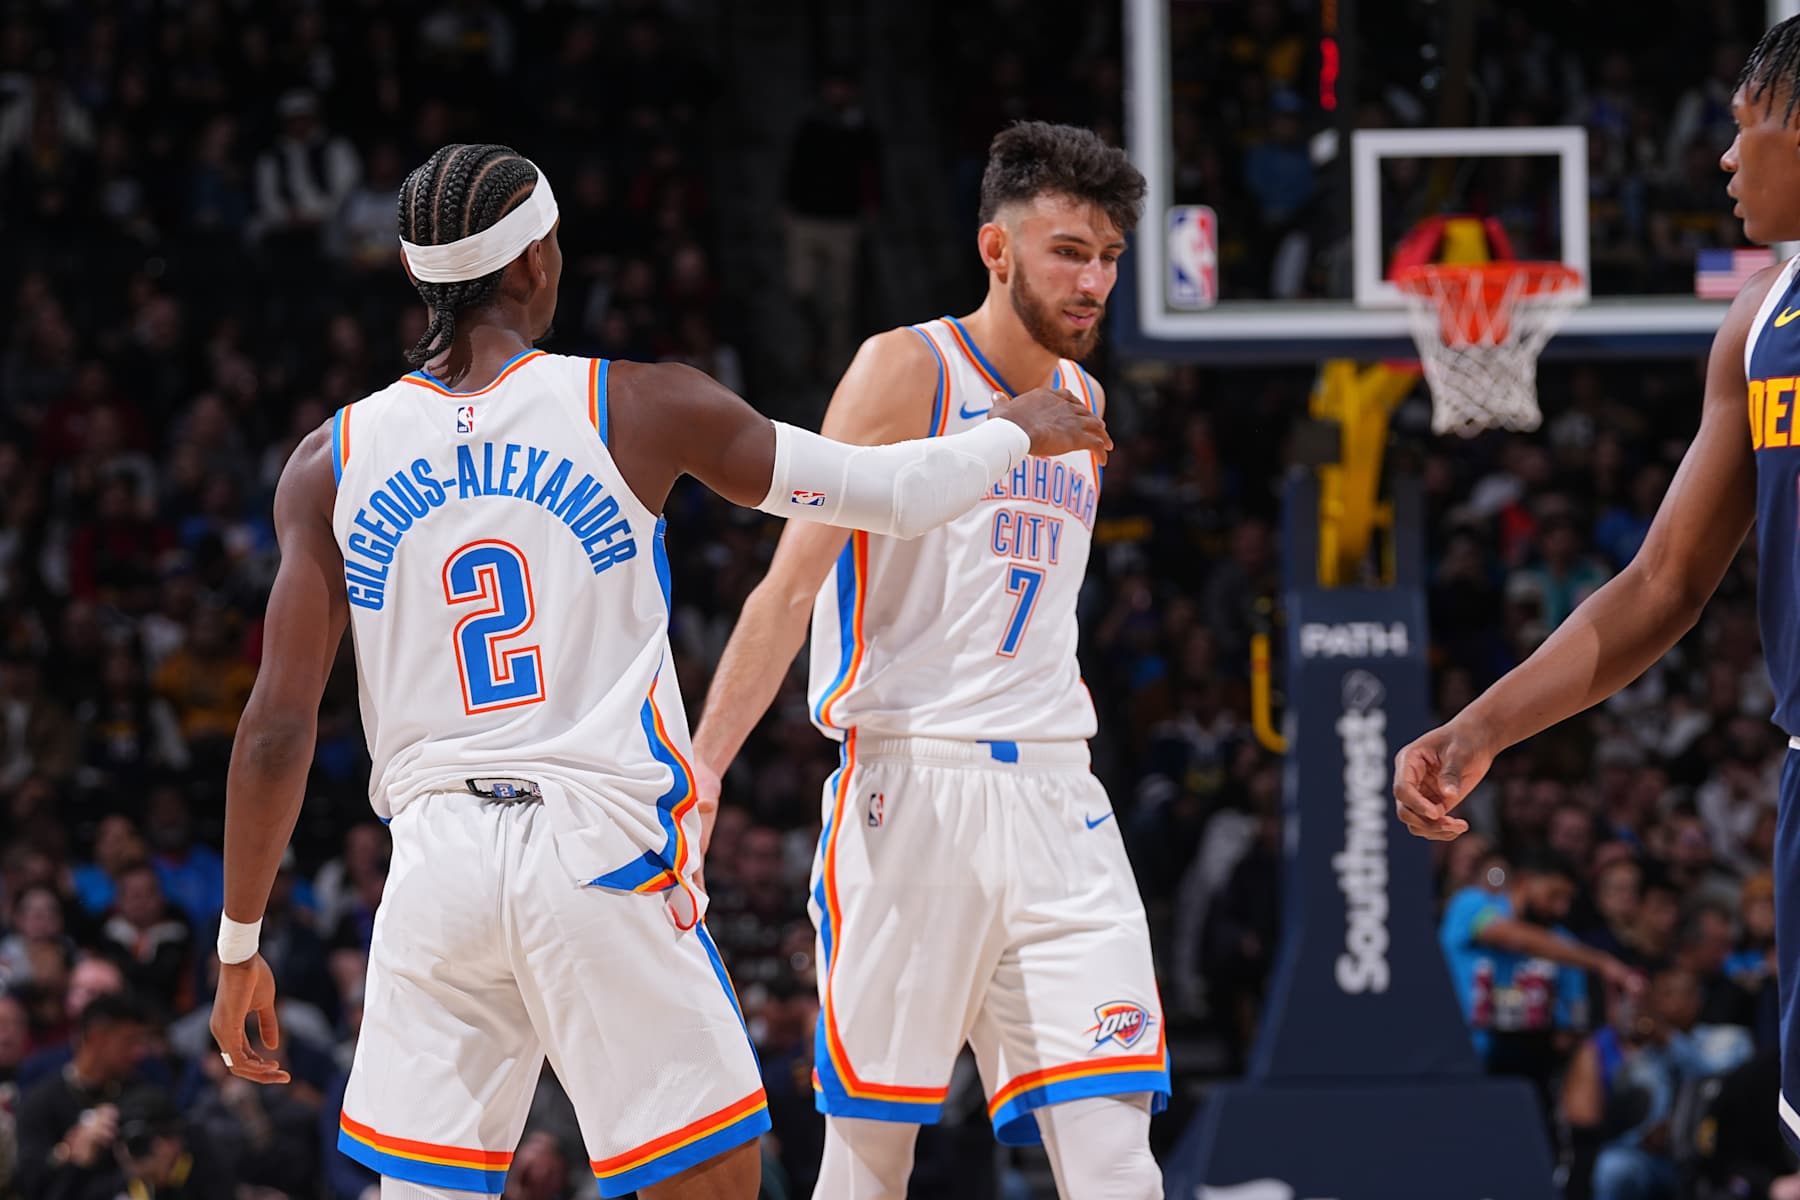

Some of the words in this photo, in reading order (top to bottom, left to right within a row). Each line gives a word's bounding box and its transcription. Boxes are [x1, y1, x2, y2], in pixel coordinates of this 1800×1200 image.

[1748, 377, 1800, 451] DE
[345, 442, 638, 612] GILGEOUS-ALEXANDER
[980, 454, 1097, 532] AHOMA
[991, 508, 1064, 566] CITY
[442, 538, 546, 716] 2
[996, 562, 1046, 659] 7
[1301, 622, 1408, 658] PATH
[1333, 709, 1391, 993] Southwest
[1096, 1010, 1139, 1042] OKC
